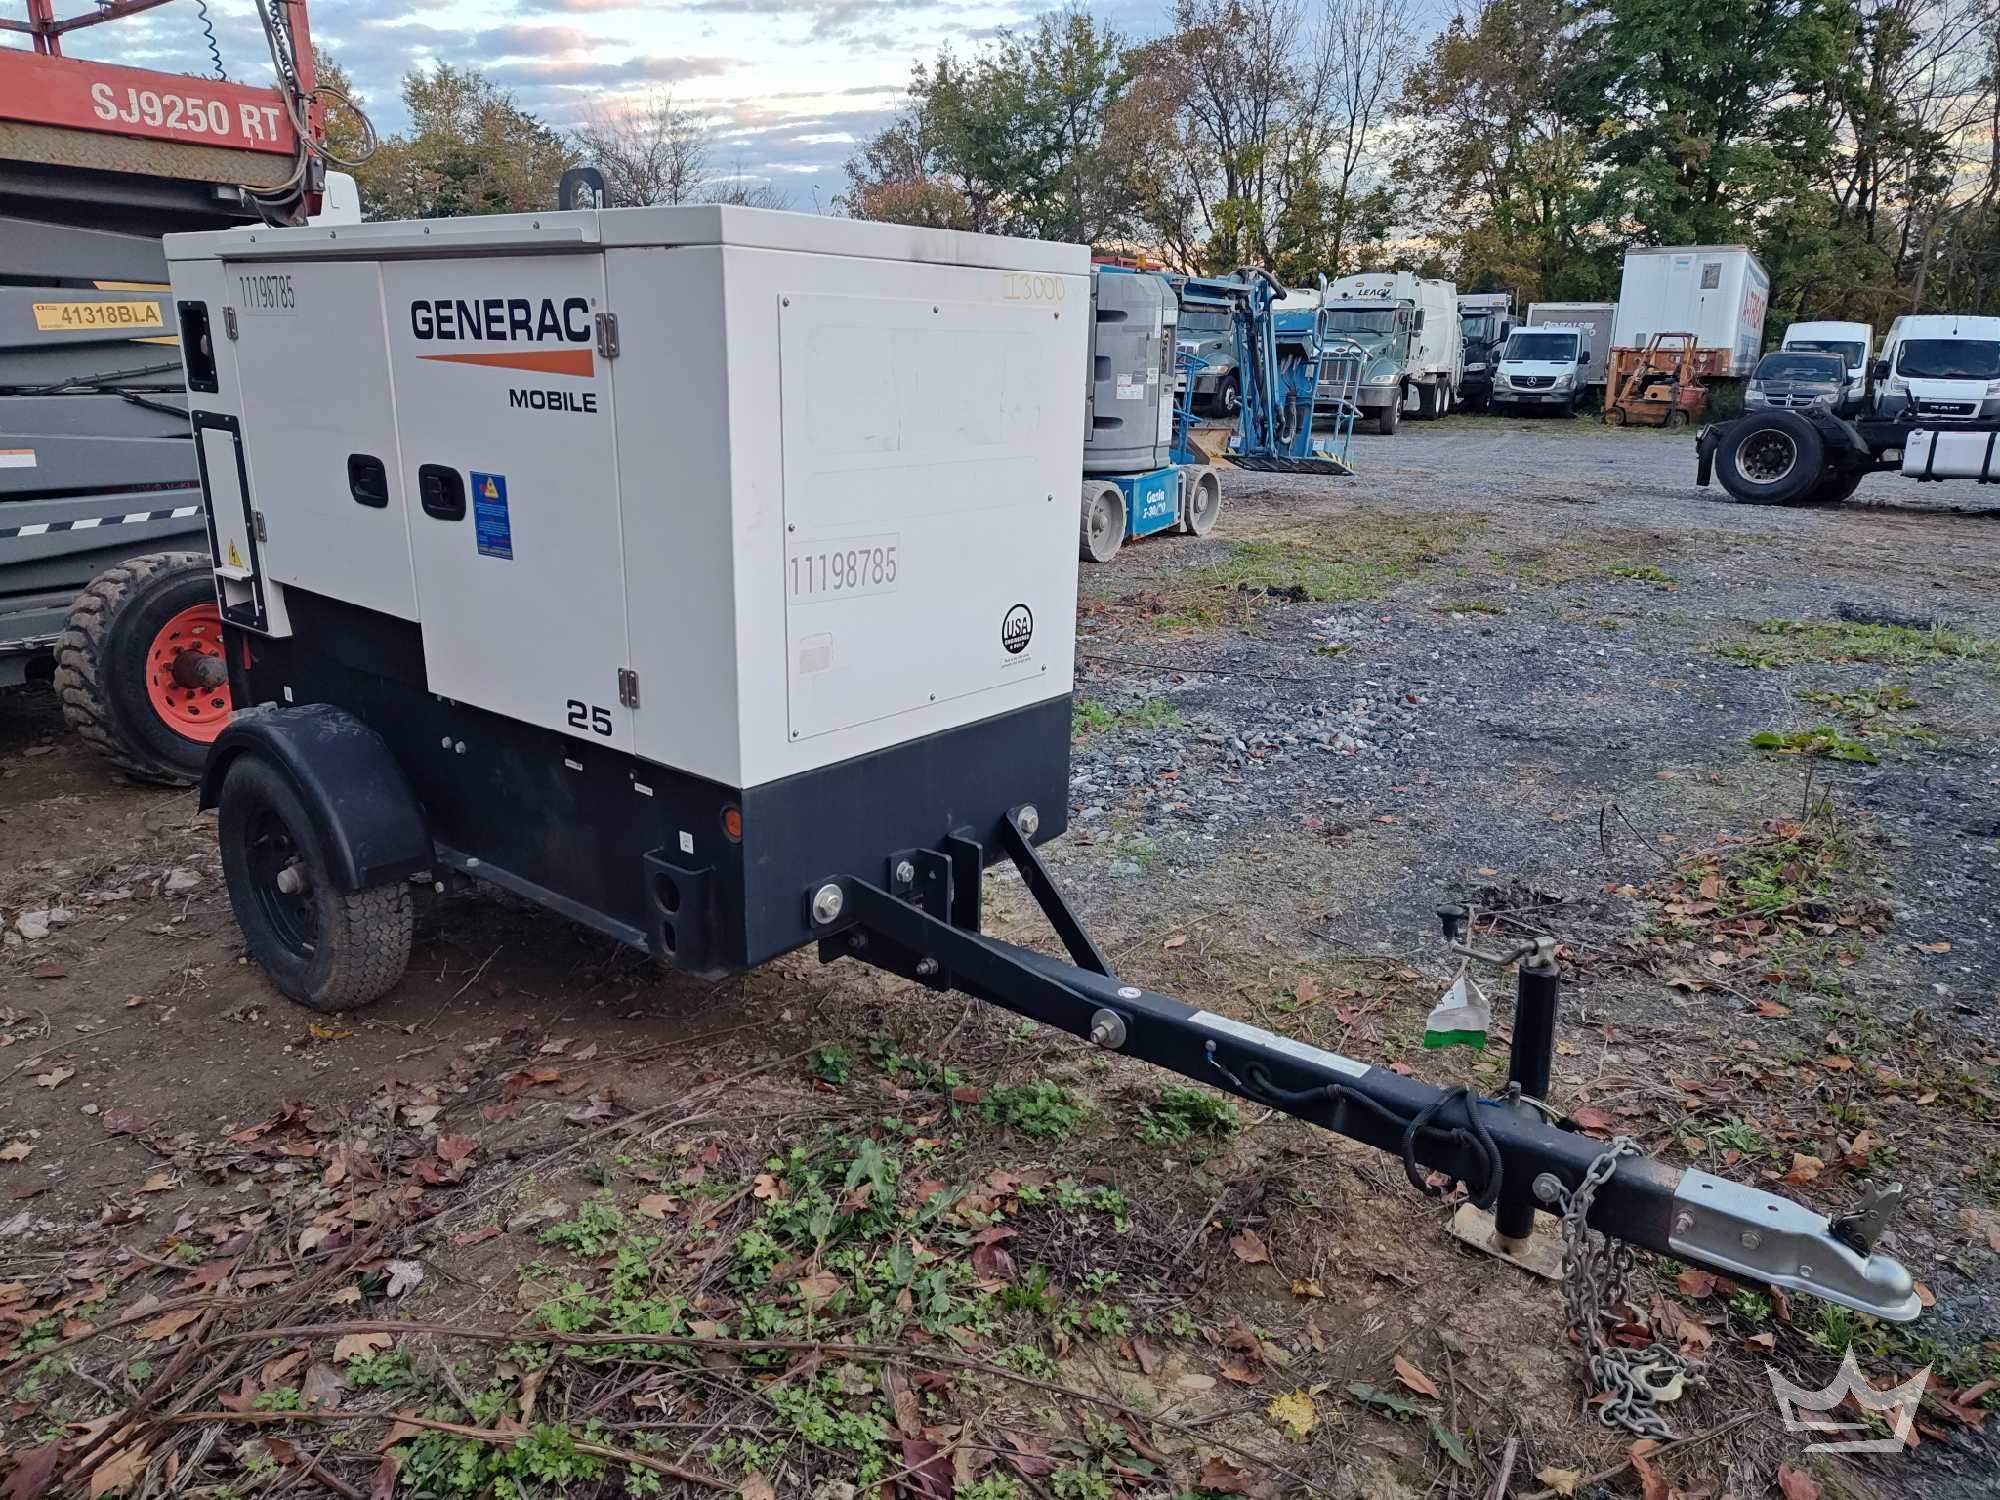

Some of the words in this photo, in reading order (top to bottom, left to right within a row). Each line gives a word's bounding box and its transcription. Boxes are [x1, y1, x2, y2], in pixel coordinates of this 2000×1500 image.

[91, 83, 230, 136] SJ9250
[239, 103, 280, 142] RT
[239, 276, 296, 309] 11198785
[61, 304, 160, 326] 41318BLA
[411, 297, 592, 343] GENERAC
[509, 389, 598, 414] MOBILE
[791, 547, 897, 595] 11198785
[1007, 616, 1028, 638] USA
[567, 699, 613, 737] 25
